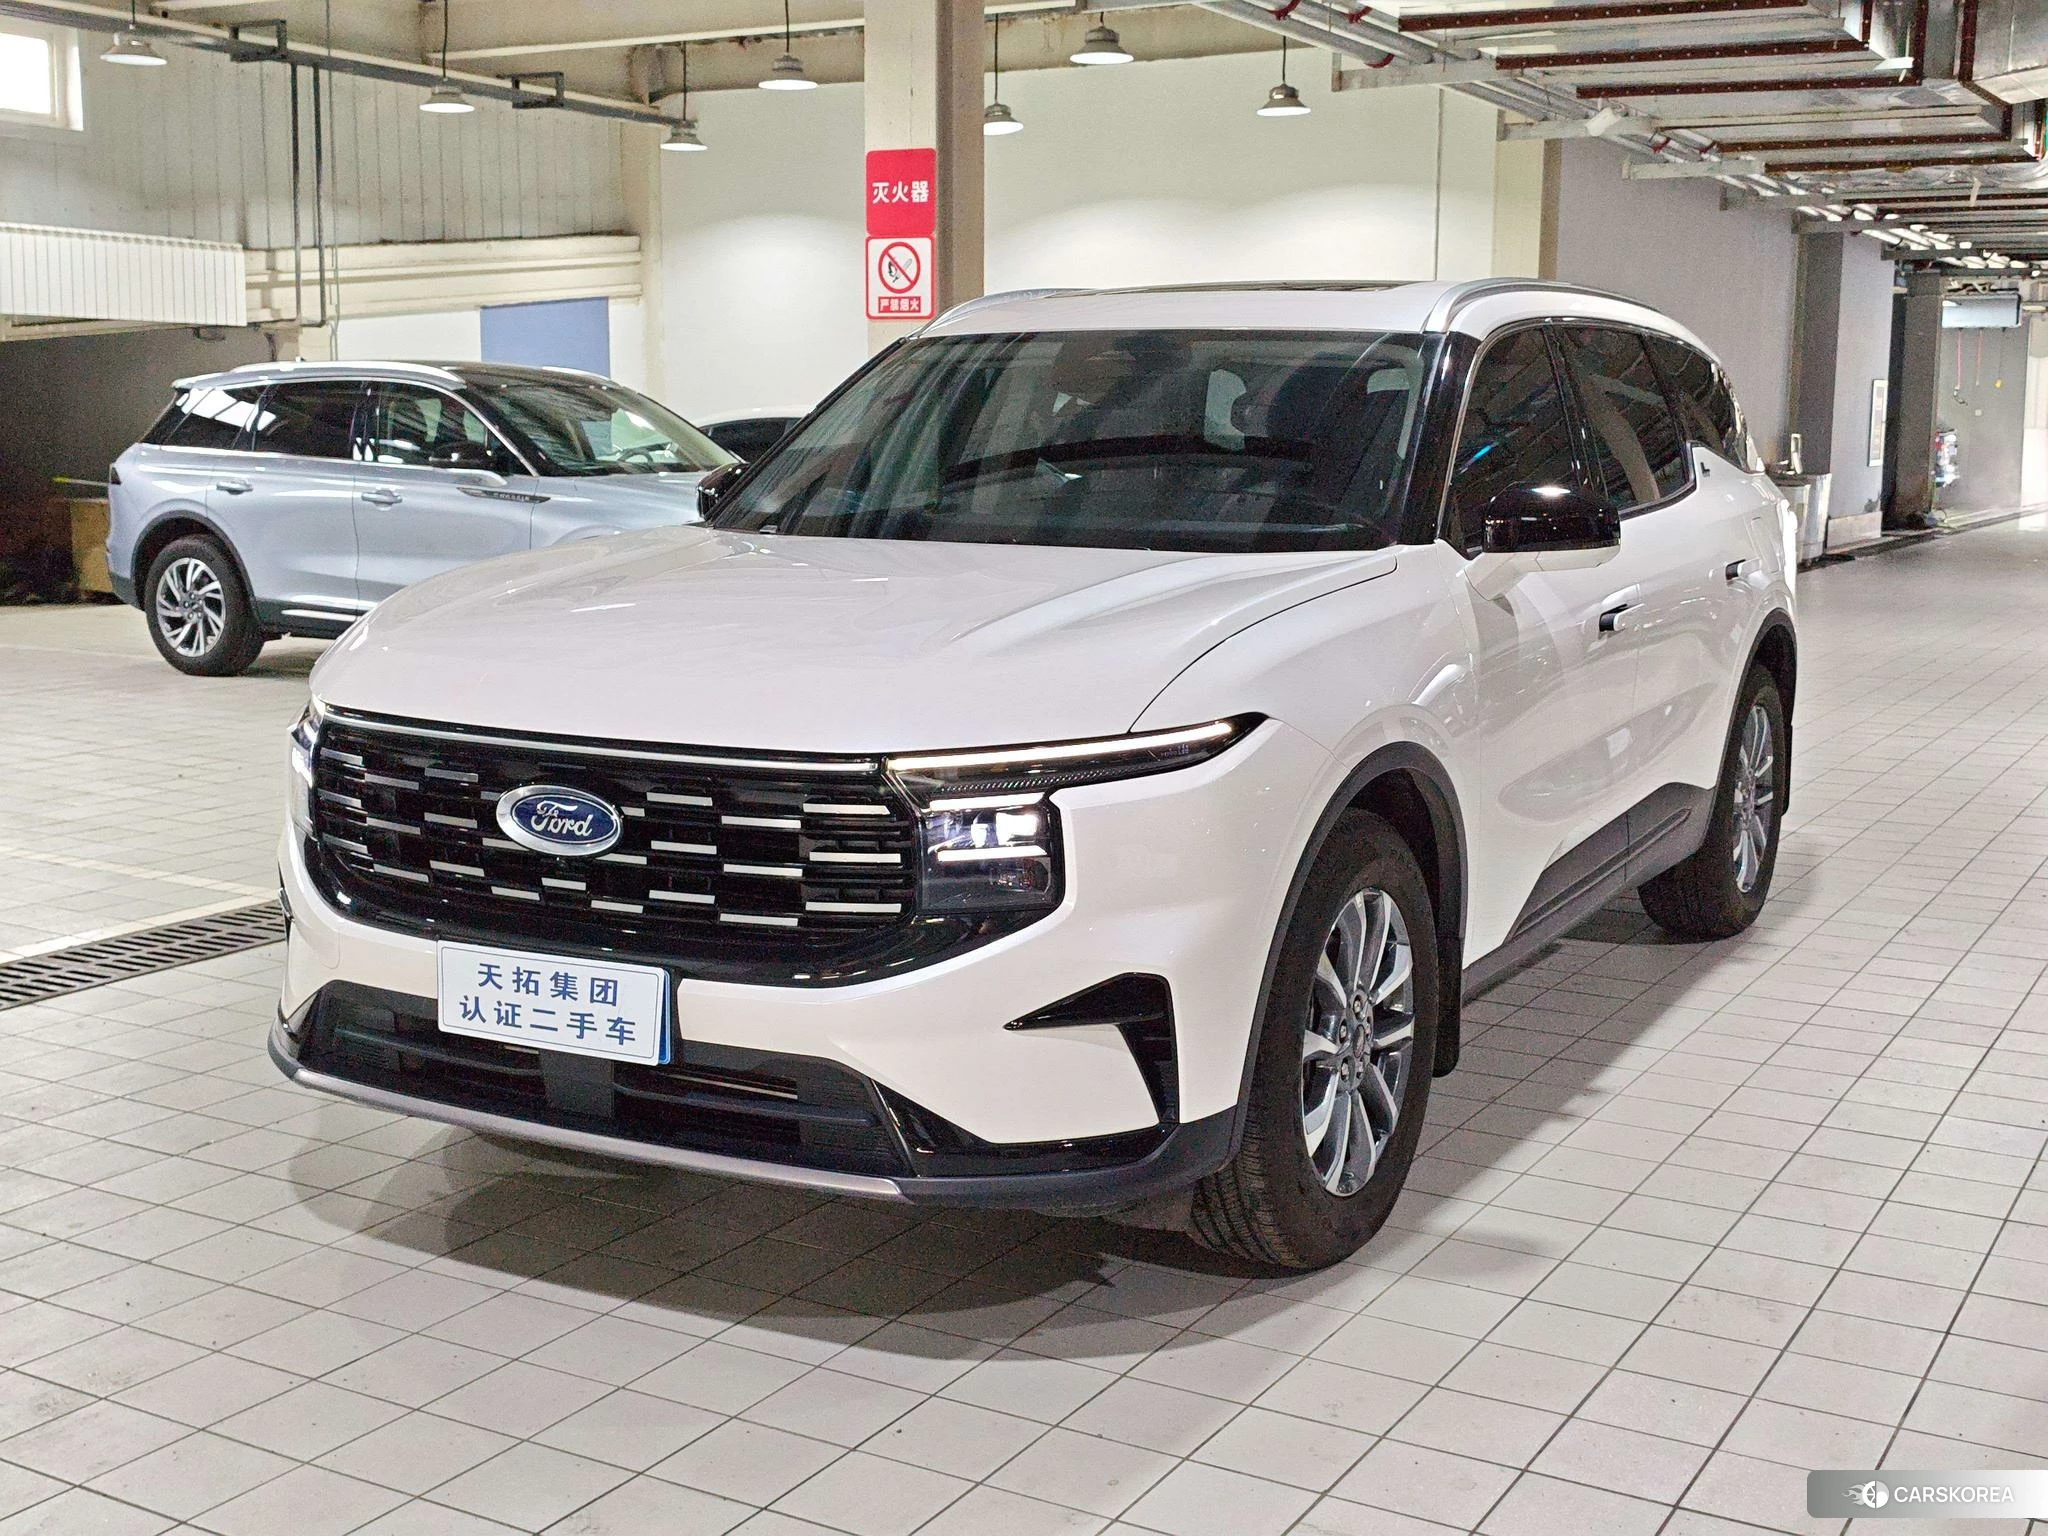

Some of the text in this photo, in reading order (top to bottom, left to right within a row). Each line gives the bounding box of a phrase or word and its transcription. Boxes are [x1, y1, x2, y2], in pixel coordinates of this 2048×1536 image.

[872, 180, 929, 204] 灭火器
[530, 799, 594, 837] Ford
[477, 962, 619, 1007] 天拓集团
[458, 995, 637, 1046] 认证二手车
